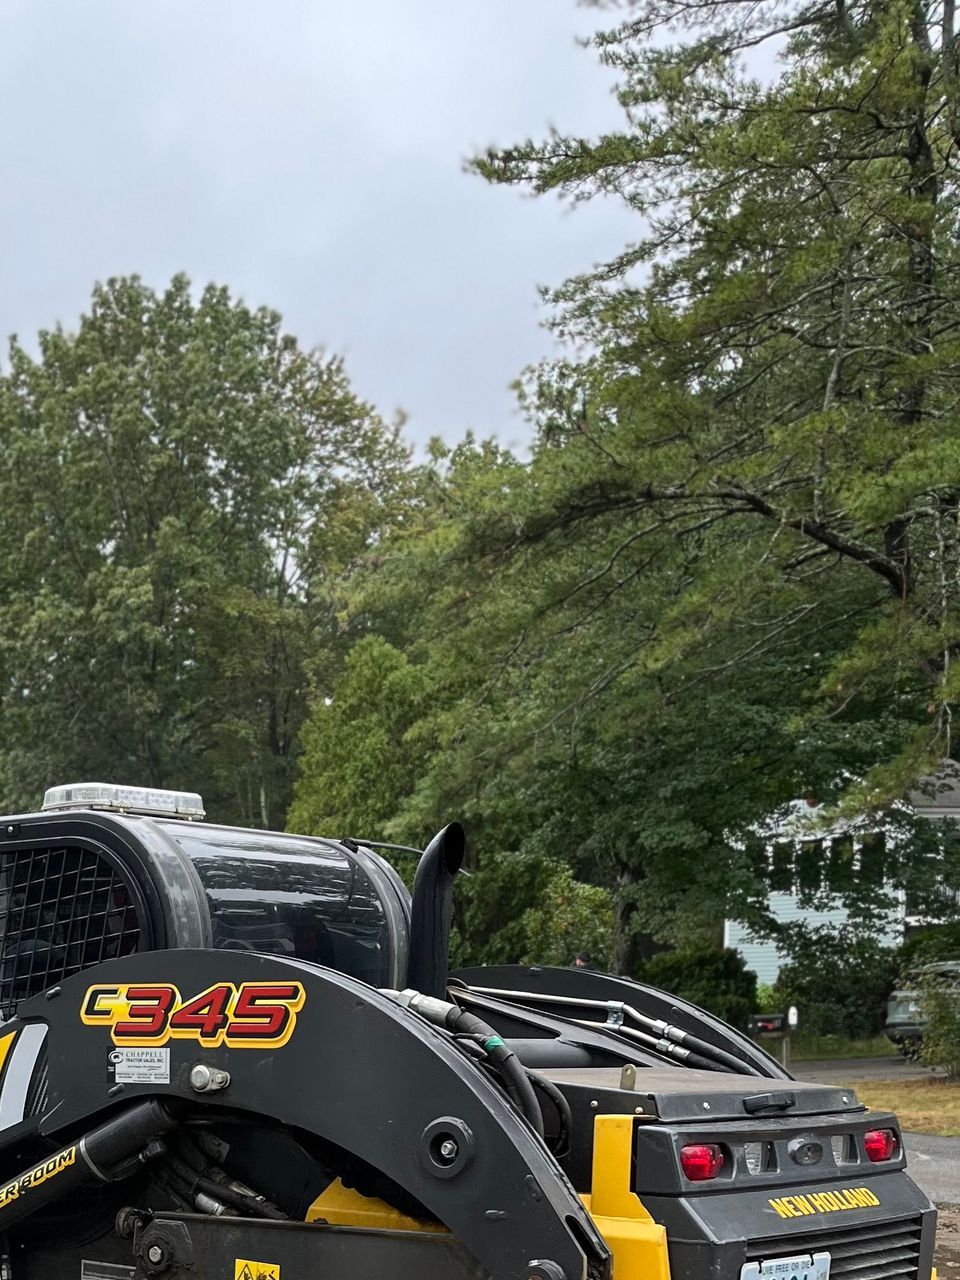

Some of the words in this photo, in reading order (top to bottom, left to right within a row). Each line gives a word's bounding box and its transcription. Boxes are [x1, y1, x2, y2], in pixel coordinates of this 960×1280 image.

[81, 983, 305, 1048] C345
[20, 1146, 76, 1187] BOOM
[768, 1195, 816, 1218] NEW
[806, 1187, 880, 1213] HOLLAND
[775, 1263, 789, 1273] FREE
[791, 1262, 800, 1271] OR
[801, 1260, 811, 1269] DIE
